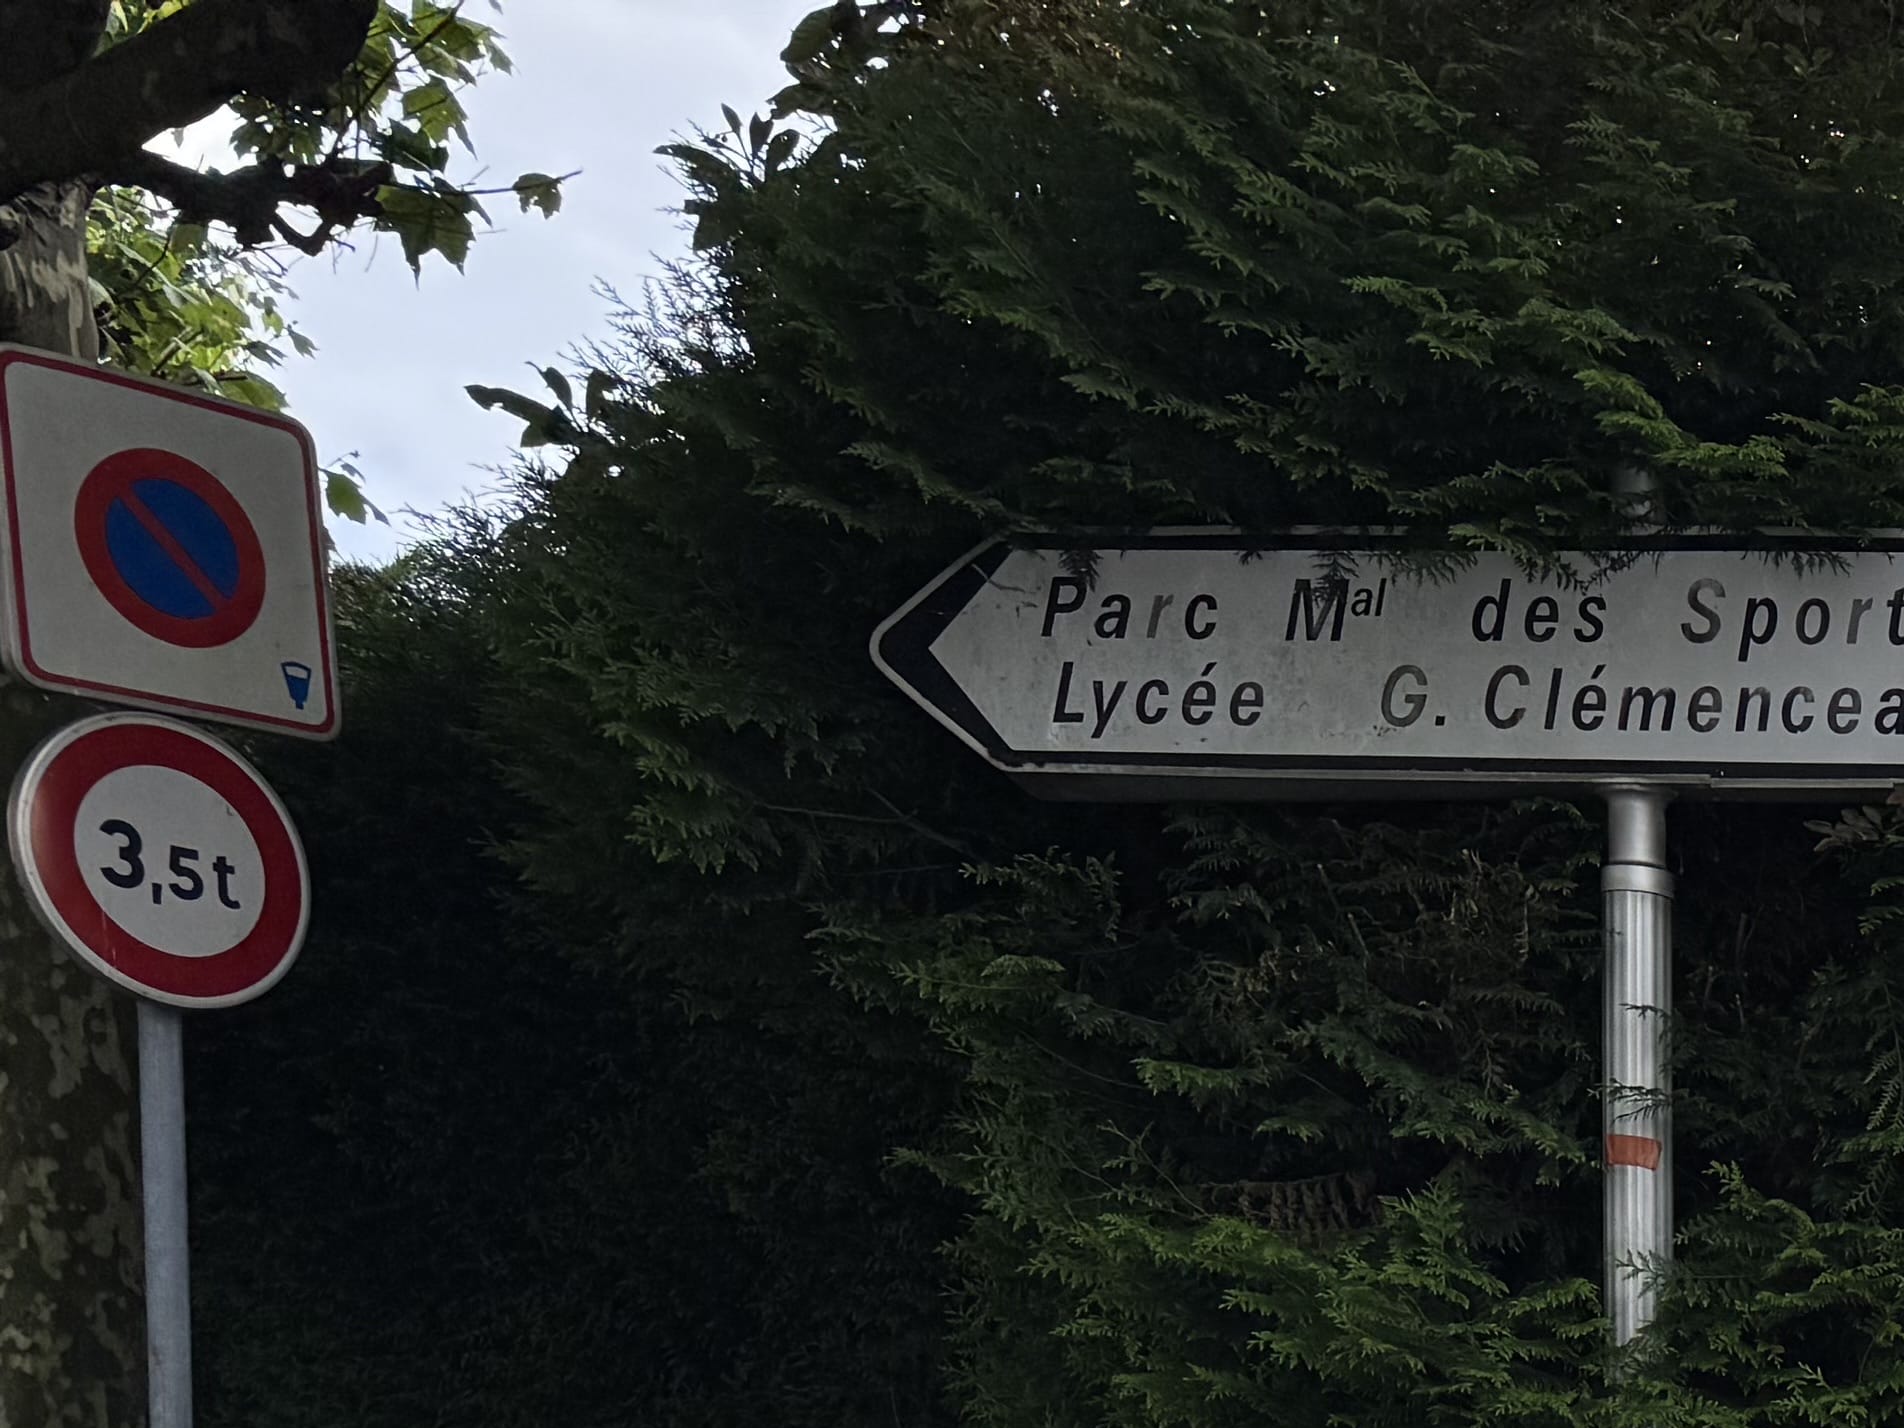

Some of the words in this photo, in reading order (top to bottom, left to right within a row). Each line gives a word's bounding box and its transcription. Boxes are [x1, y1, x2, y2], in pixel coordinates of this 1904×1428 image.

[1041, 575, 1218, 640] Parc
[1471, 577, 1608, 643] des
[1052, 660, 1264, 739] Lycée
[1380, 663, 1447, 728] G.
[98, 818, 241, 910] 3,5t
